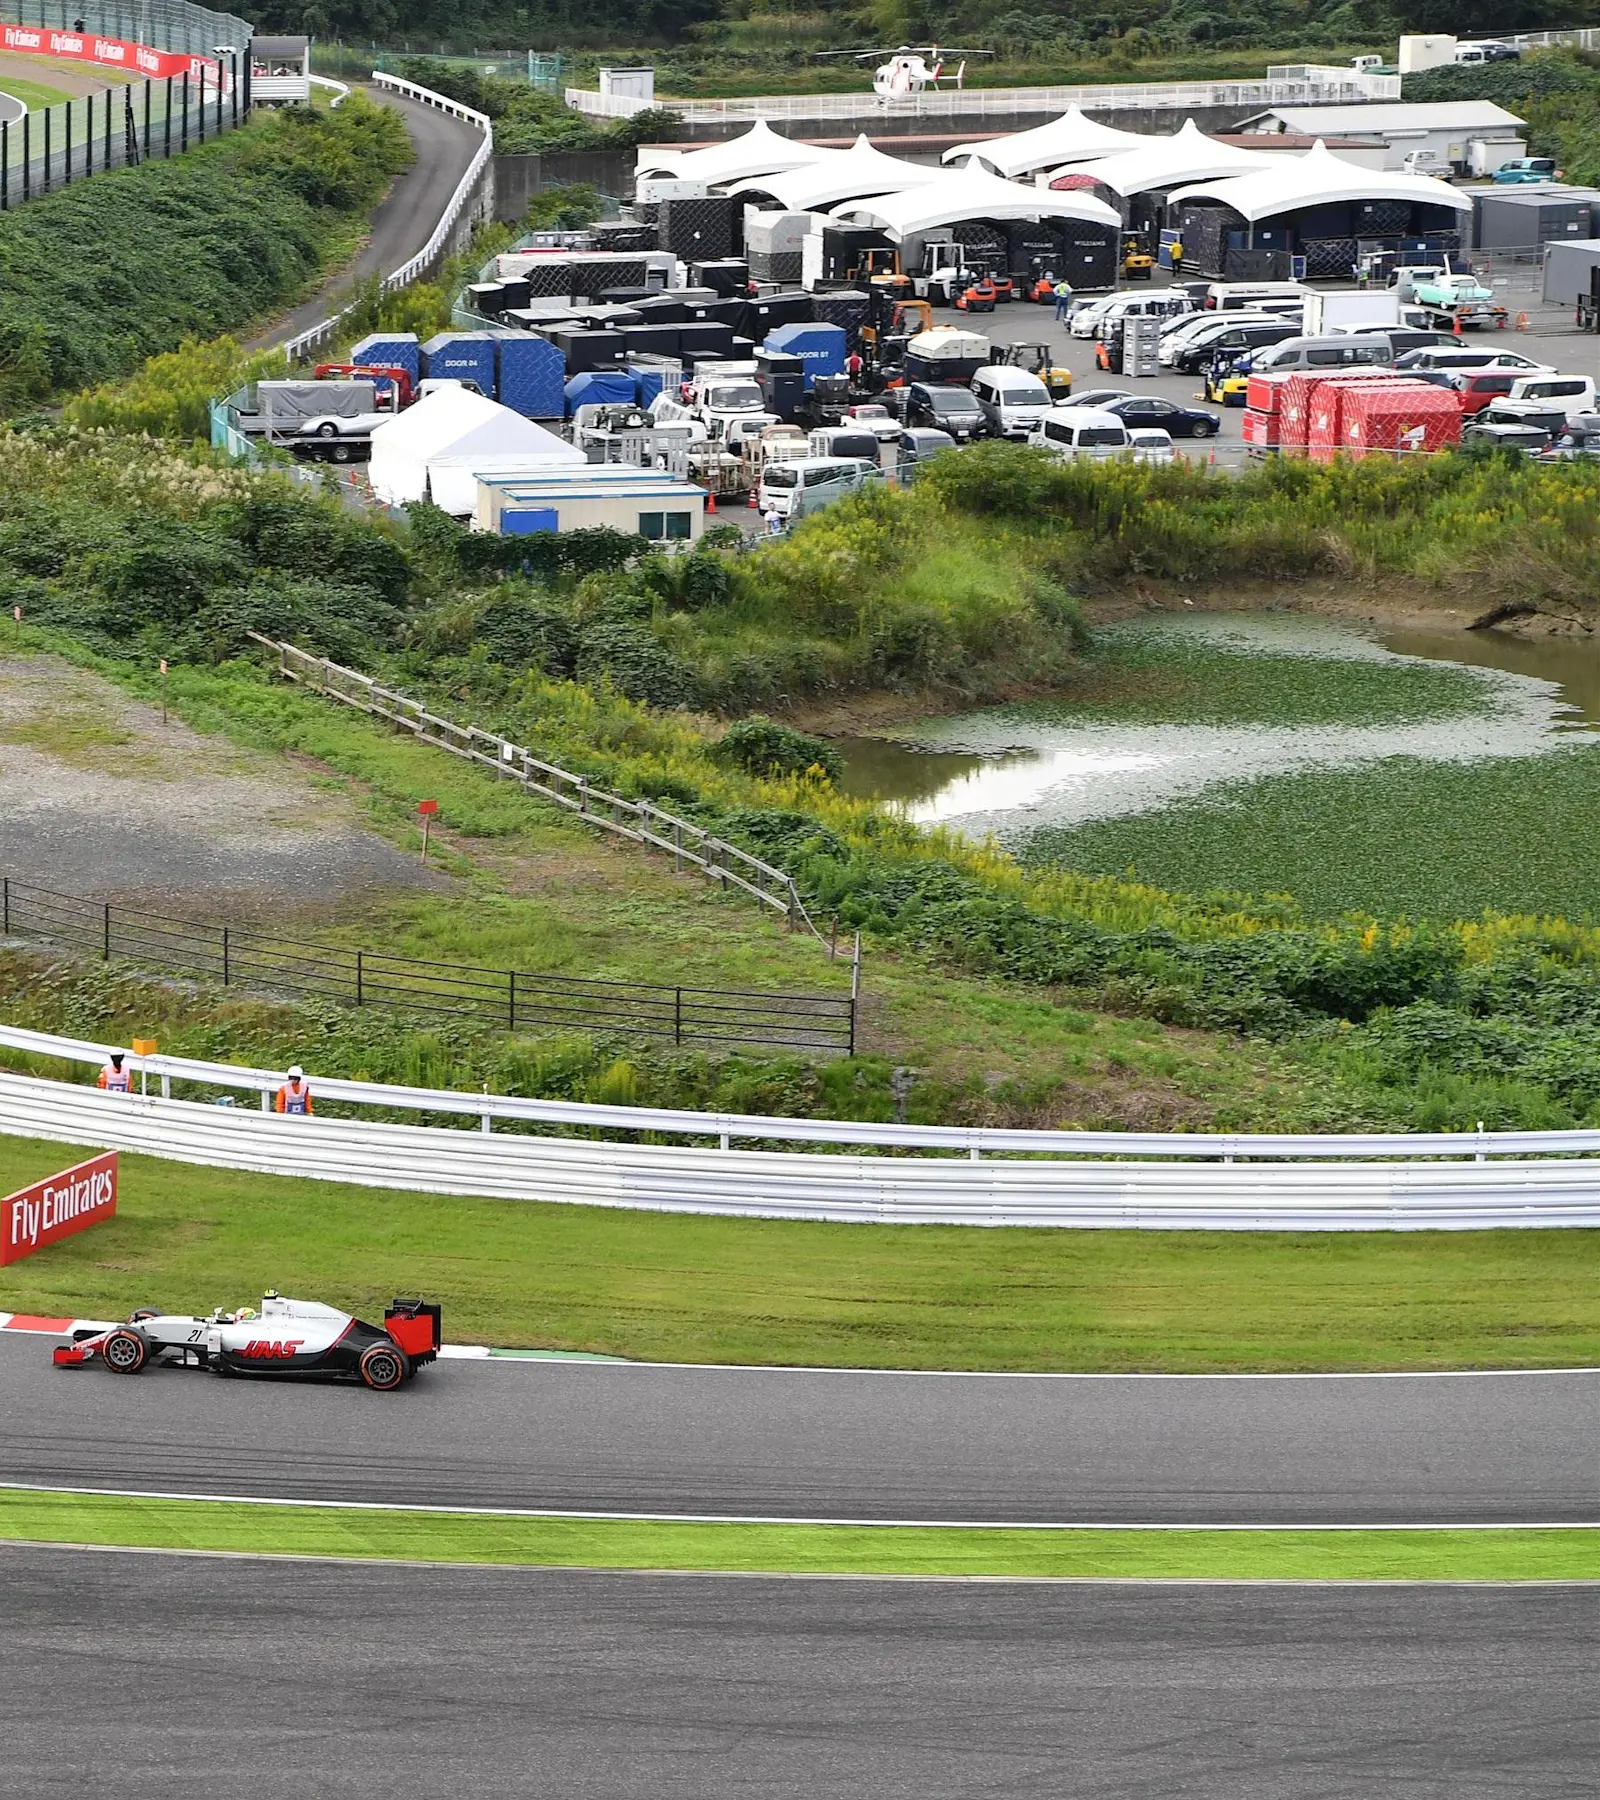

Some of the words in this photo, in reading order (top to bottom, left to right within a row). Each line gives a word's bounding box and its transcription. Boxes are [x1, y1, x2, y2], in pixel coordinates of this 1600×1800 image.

[796, 351, 820, 359] DOOR
[445, 359, 468, 367] DOOR
[11, 1198, 40, 1246] Fly
[42, 1169, 113, 1230] Emirates
[187, 1329, 203, 1342] 21
[232, 1340, 305, 1360] HAAS
